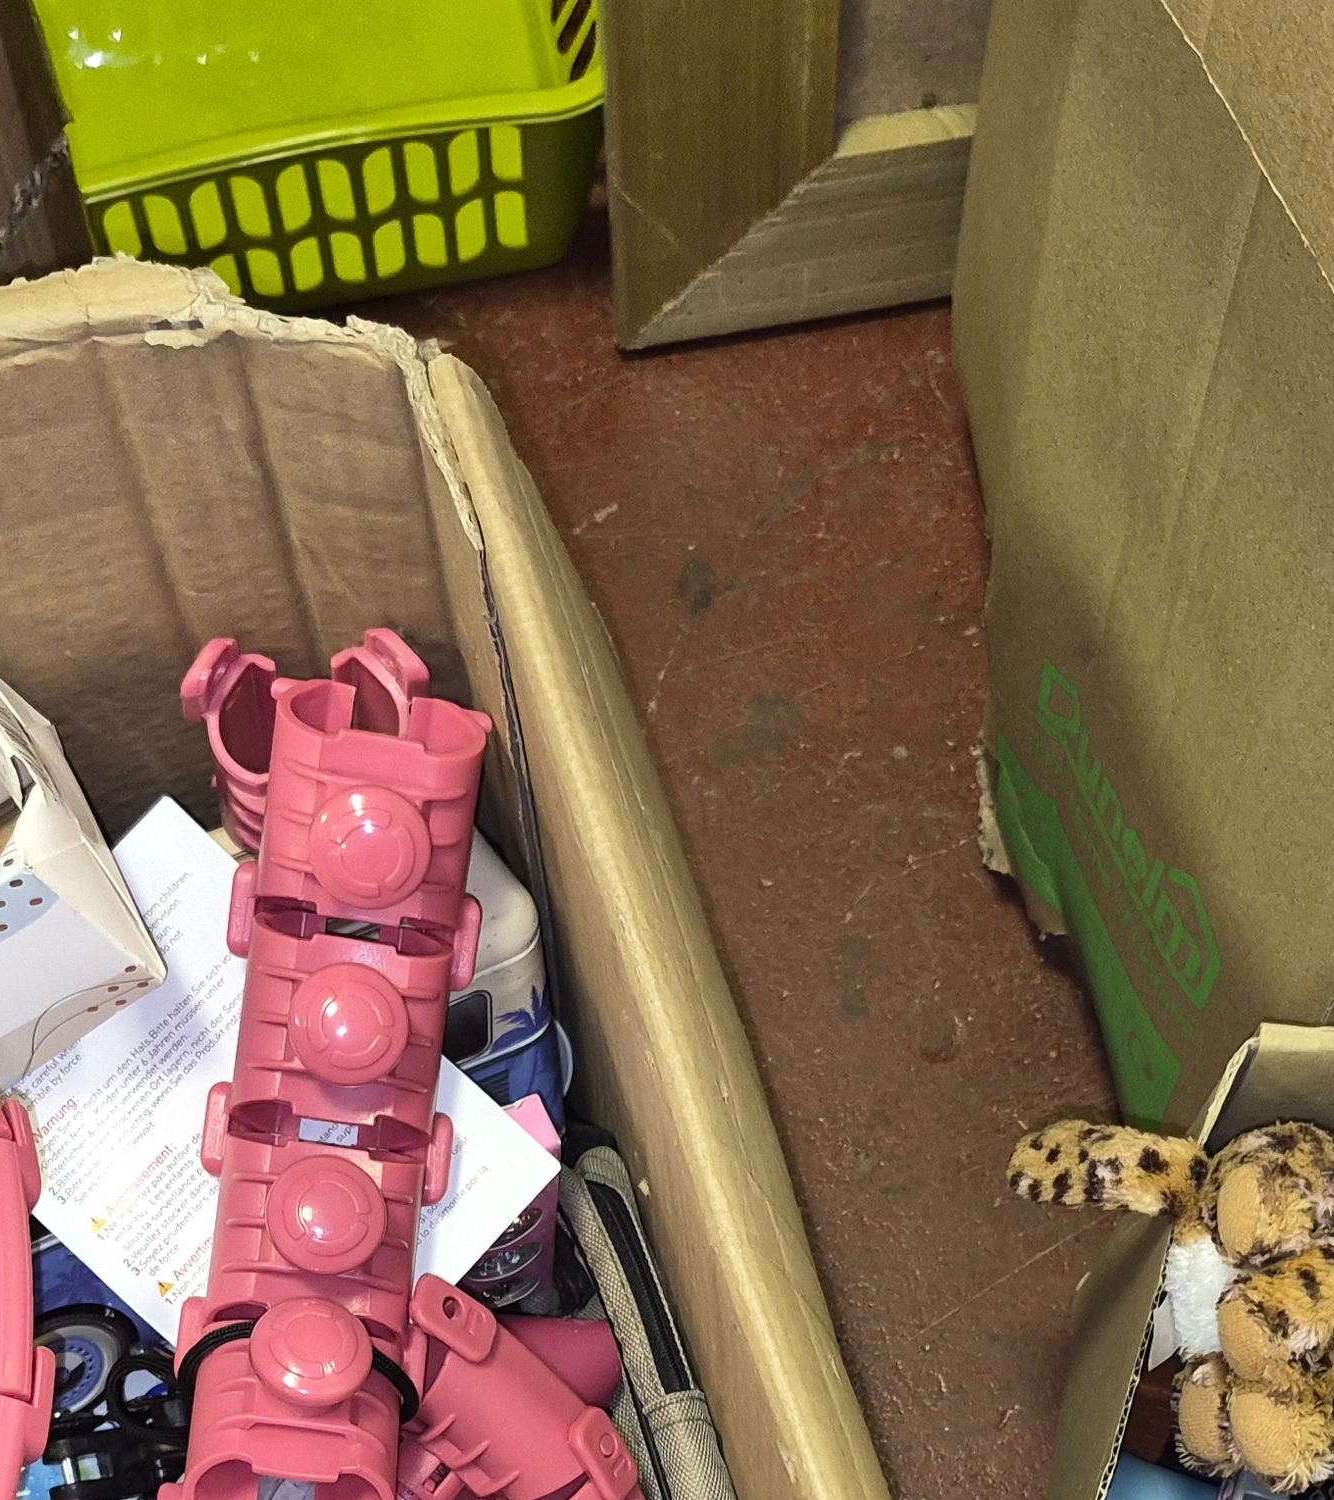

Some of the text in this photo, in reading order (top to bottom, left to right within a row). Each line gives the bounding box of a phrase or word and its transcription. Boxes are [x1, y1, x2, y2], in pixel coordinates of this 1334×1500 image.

[1037, 659, 1215, 1003] Dunelm
[156, 867, 193, 905] children,
[167, 929, 184, 946] not
[114, 1055, 134, 1076] den
[166, 991, 194, 1020] halten
[145, 1028, 176, 1060] Jahren
[202, 975, 227, 1001] unter
[28, 1057, 60, 1089] careful
[147, 1073, 166, 1092] Ort
[188, 1025, 212, 1050] nicht
[168, 1070, 185, 1087] Sie
[179, 1056, 198, 1075] das
[193, 1026, 226, 1061] Produkt
[147, 1186, 167, 1206] Les
[161, 1155, 195, 1190] enfants
[149, 1169, 169, 1189] pas
[163, 1141, 193, 1172] autour
[148, 1171, 198, 1223] surveillance
[157, 1196, 191, 1230] stocker
[186, 1175, 210, 1200] dans
[159, 1209, 195, 1246] prudent
[189, 1193, 210, 1214] lors
[425, 1186, 468, 1230] desmonte
[146, 1262, 161, 1277] de
